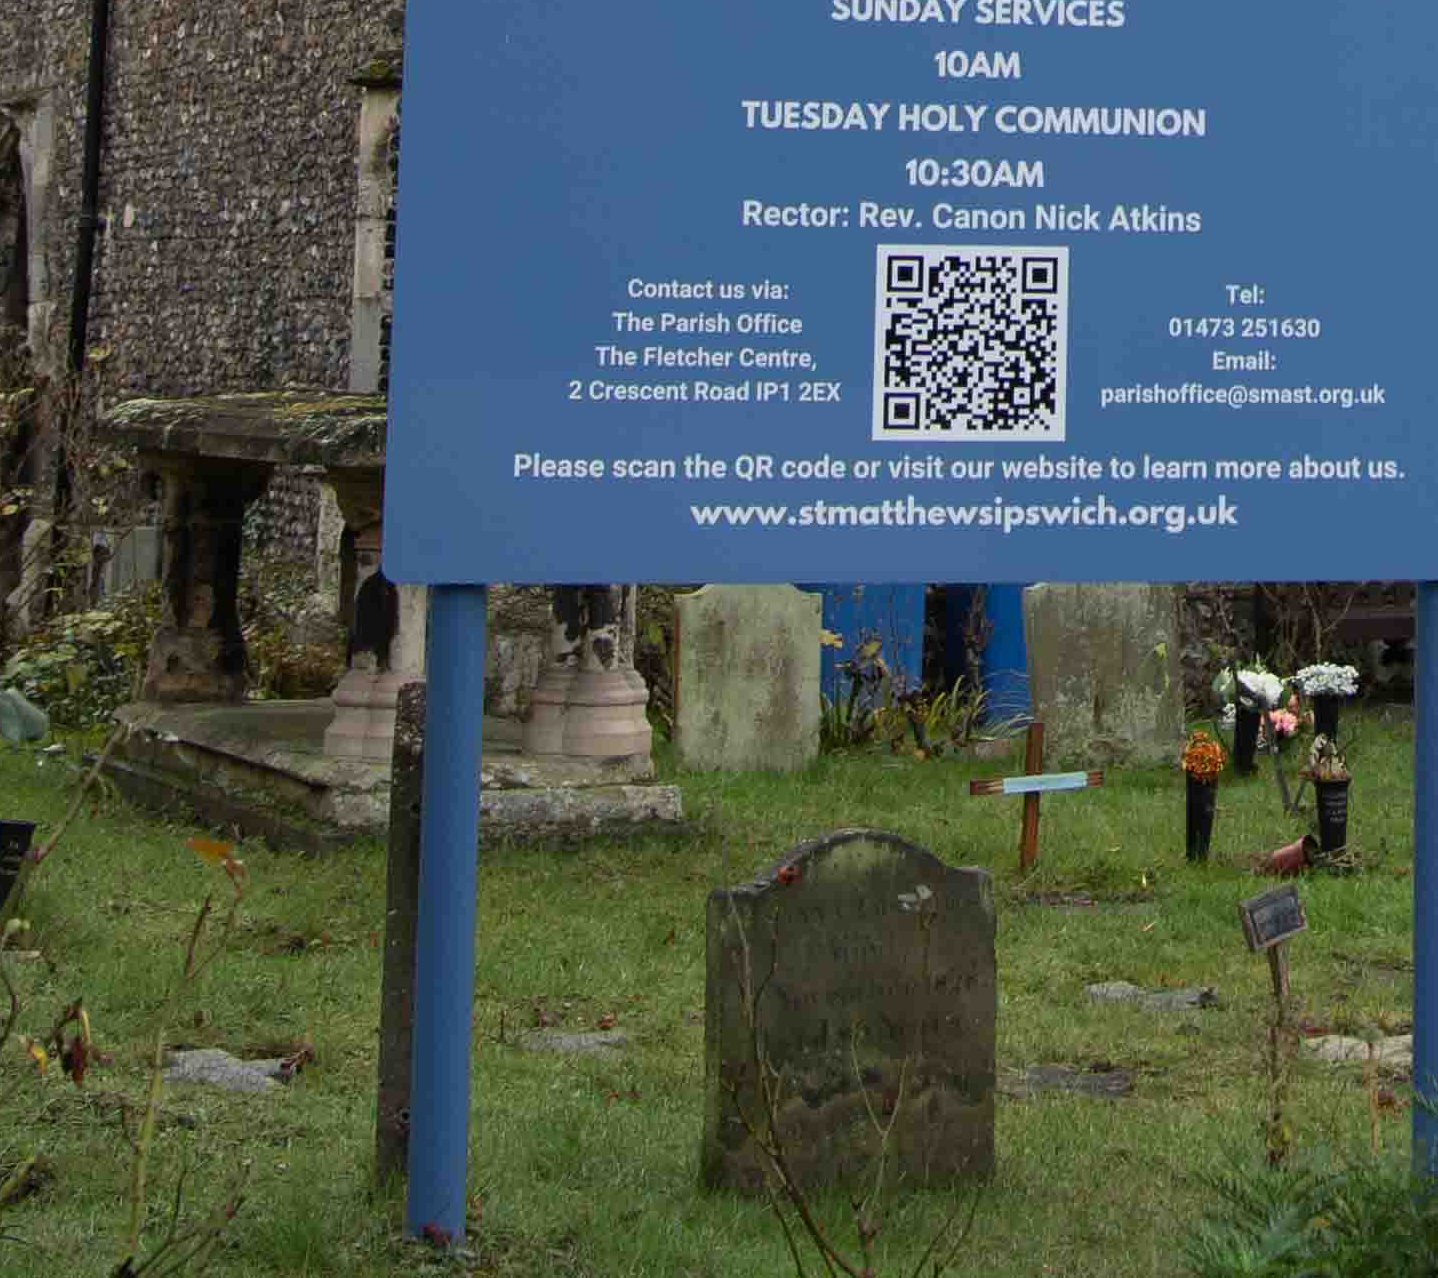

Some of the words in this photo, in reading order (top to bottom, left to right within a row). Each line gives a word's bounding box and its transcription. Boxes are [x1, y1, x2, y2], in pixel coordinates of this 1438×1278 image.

[934, 50, 1021, 79] 10AM
[741, 100, 891, 131] TUESDAY
[898, 103, 988, 132] HOLY
[994, 105, 1206, 137] COMMUNION
[905, 158, 1044, 188] 10:30AM
[742, 200, 849, 228] Rector:
[859, 201, 923, 228] Rev.
[932, 202, 1026, 230] Canon
[1035, 203, 1101, 231] Nick
[1108, 203, 1202, 233] Atkins
[627, 278, 714, 300] Contact
[719, 283, 745, 300] us
[751, 279, 789, 300] via:
[1225, 284, 1265, 305] Tel:
[612, 311, 655, 332] The
[660, 312, 731, 333] Parish
[736, 312, 803, 334] Office
[1169, 317, 1235, 338] 01473
[1241, 317, 1321, 338] 251630
[594, 345, 638, 366] The
[643, 346, 734, 368] Fletcher
[739, 347, 817, 372] Centre,
[1212, 350, 1276, 371] Email:
[569, 380, 582, 400] 2
[589, 380, 689, 401] Crescent
[694, 380, 750, 402] Road
[756, 381, 790, 402] IP1
[798, 381, 841, 402] 2EX
[1101, 382, 1386, 409] parishoffice@smast.org.uk
[513, 452, 605, 478] Please
[612, 459, 676, 479] scan
[683, 453, 727, 479] the
[735, 454, 774, 482] QR
[781, 454, 846, 479] code
[853, 460, 882, 479] or
[888, 455, 945, 479] visit
[950, 460, 995, 480] our
[1001, 454, 1103, 480] website
[1109, 457, 1136, 480] to
[1143, 454, 1207, 480] learn
[1214, 460, 1282, 479] more
[1288, 454, 1361, 479] about
[1367, 460, 1405, 479] us.
[690, 494, 1238, 534] www.stmatthewsipswich.org.uk
